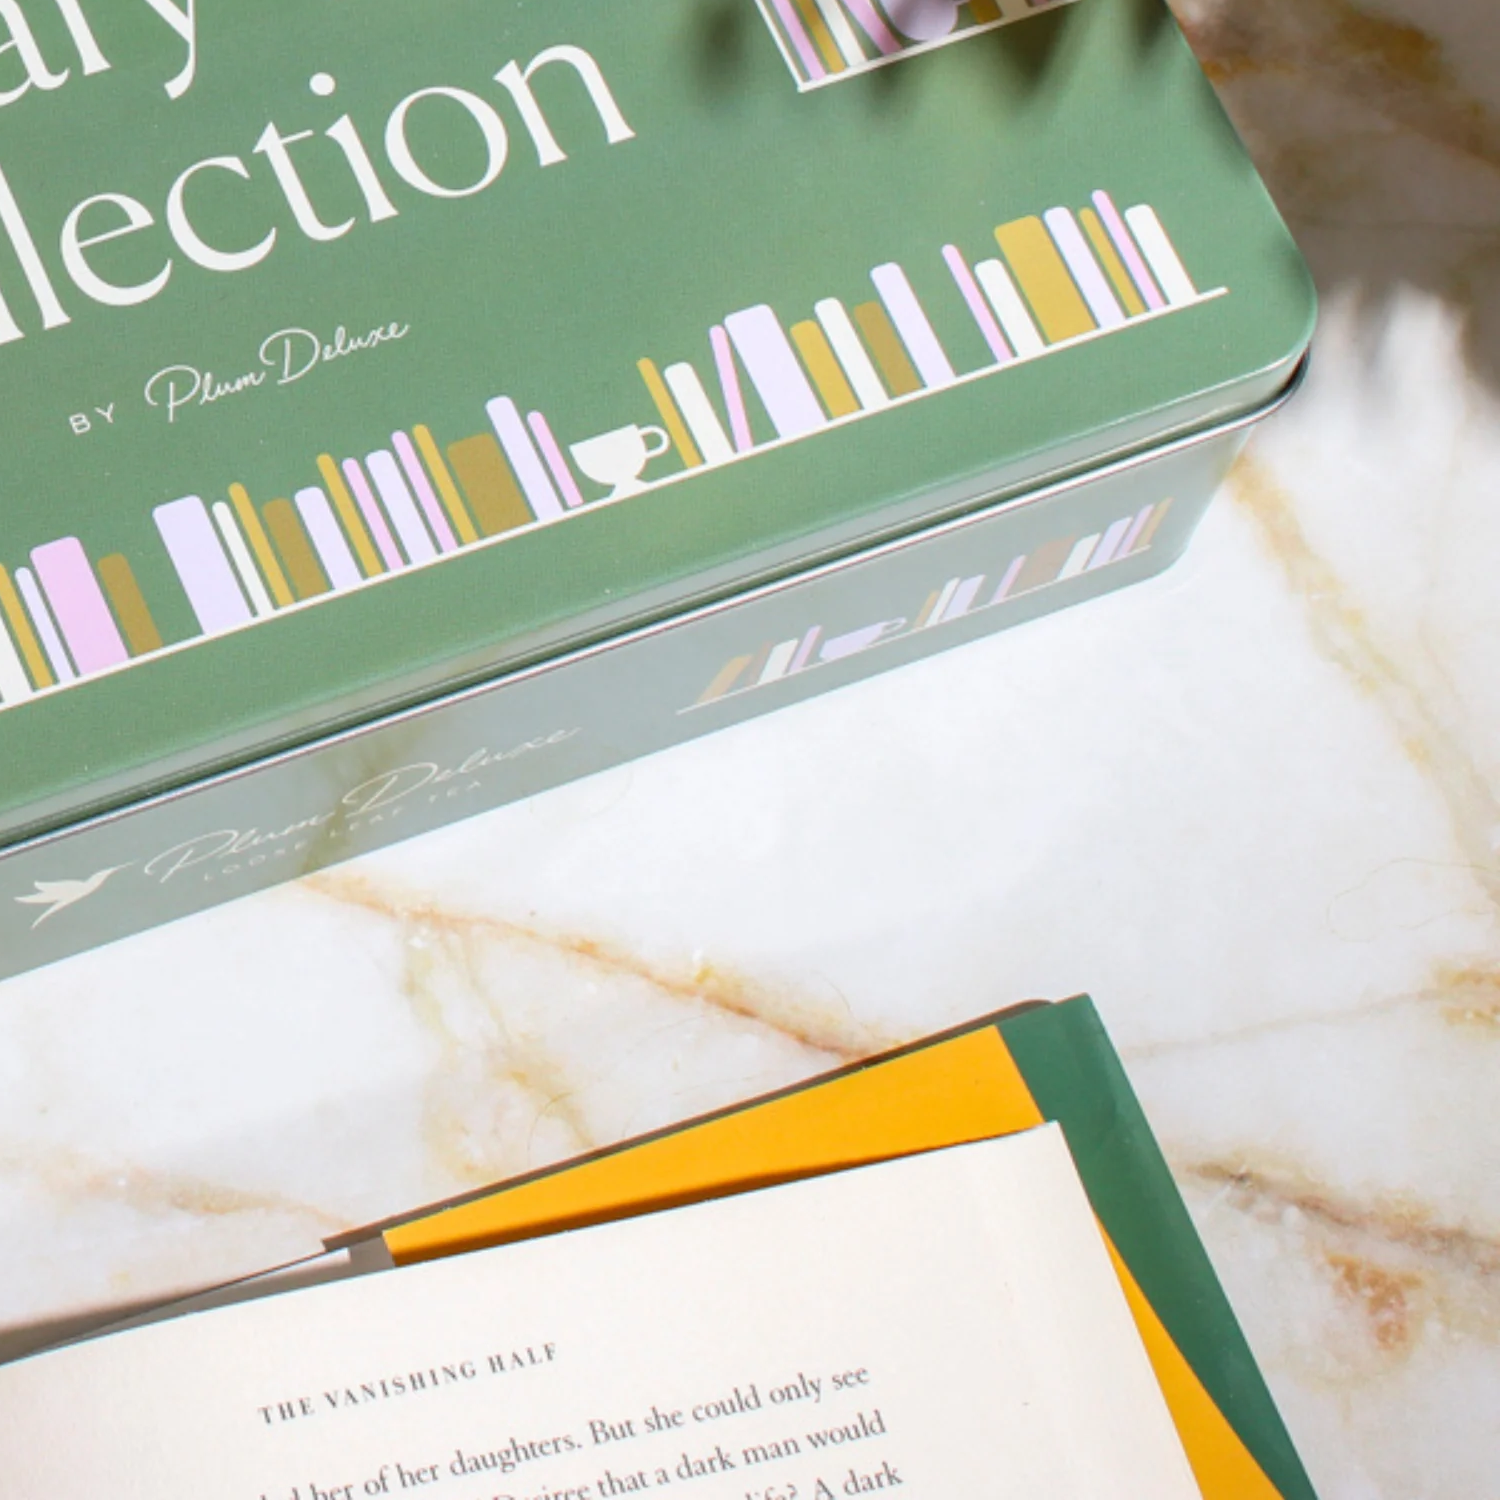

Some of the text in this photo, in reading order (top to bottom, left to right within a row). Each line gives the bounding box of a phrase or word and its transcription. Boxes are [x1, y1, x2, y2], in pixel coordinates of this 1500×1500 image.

[68, 322, 411, 435] BY Plum Deluxe
[143, 726, 583, 885] Plum Deluxe
[256, 1341, 558, 1426] THE VANISHING HALF
[363, 1464, 390, 1496] of
[394, 1461, 440, 1489] her
[448, 1436, 584, 1474] daughters.
[588, 1418, 637, 1445] But
[642, 1405, 686, 1435] she
[691, 1383, 763, 1423] could
[768, 1371, 823, 1404] only
[830, 1366, 871, 1391] see
[596, 1469, 650, 1498] that
[654, 1467, 671, 1486] a
[675, 1445, 737, 1481] dark
[741, 1437, 802, 1466] man
[805, 1408, 887, 1450] would
[815, 1477, 837, 1500] A
[842, 1459, 904, 1496] dark
